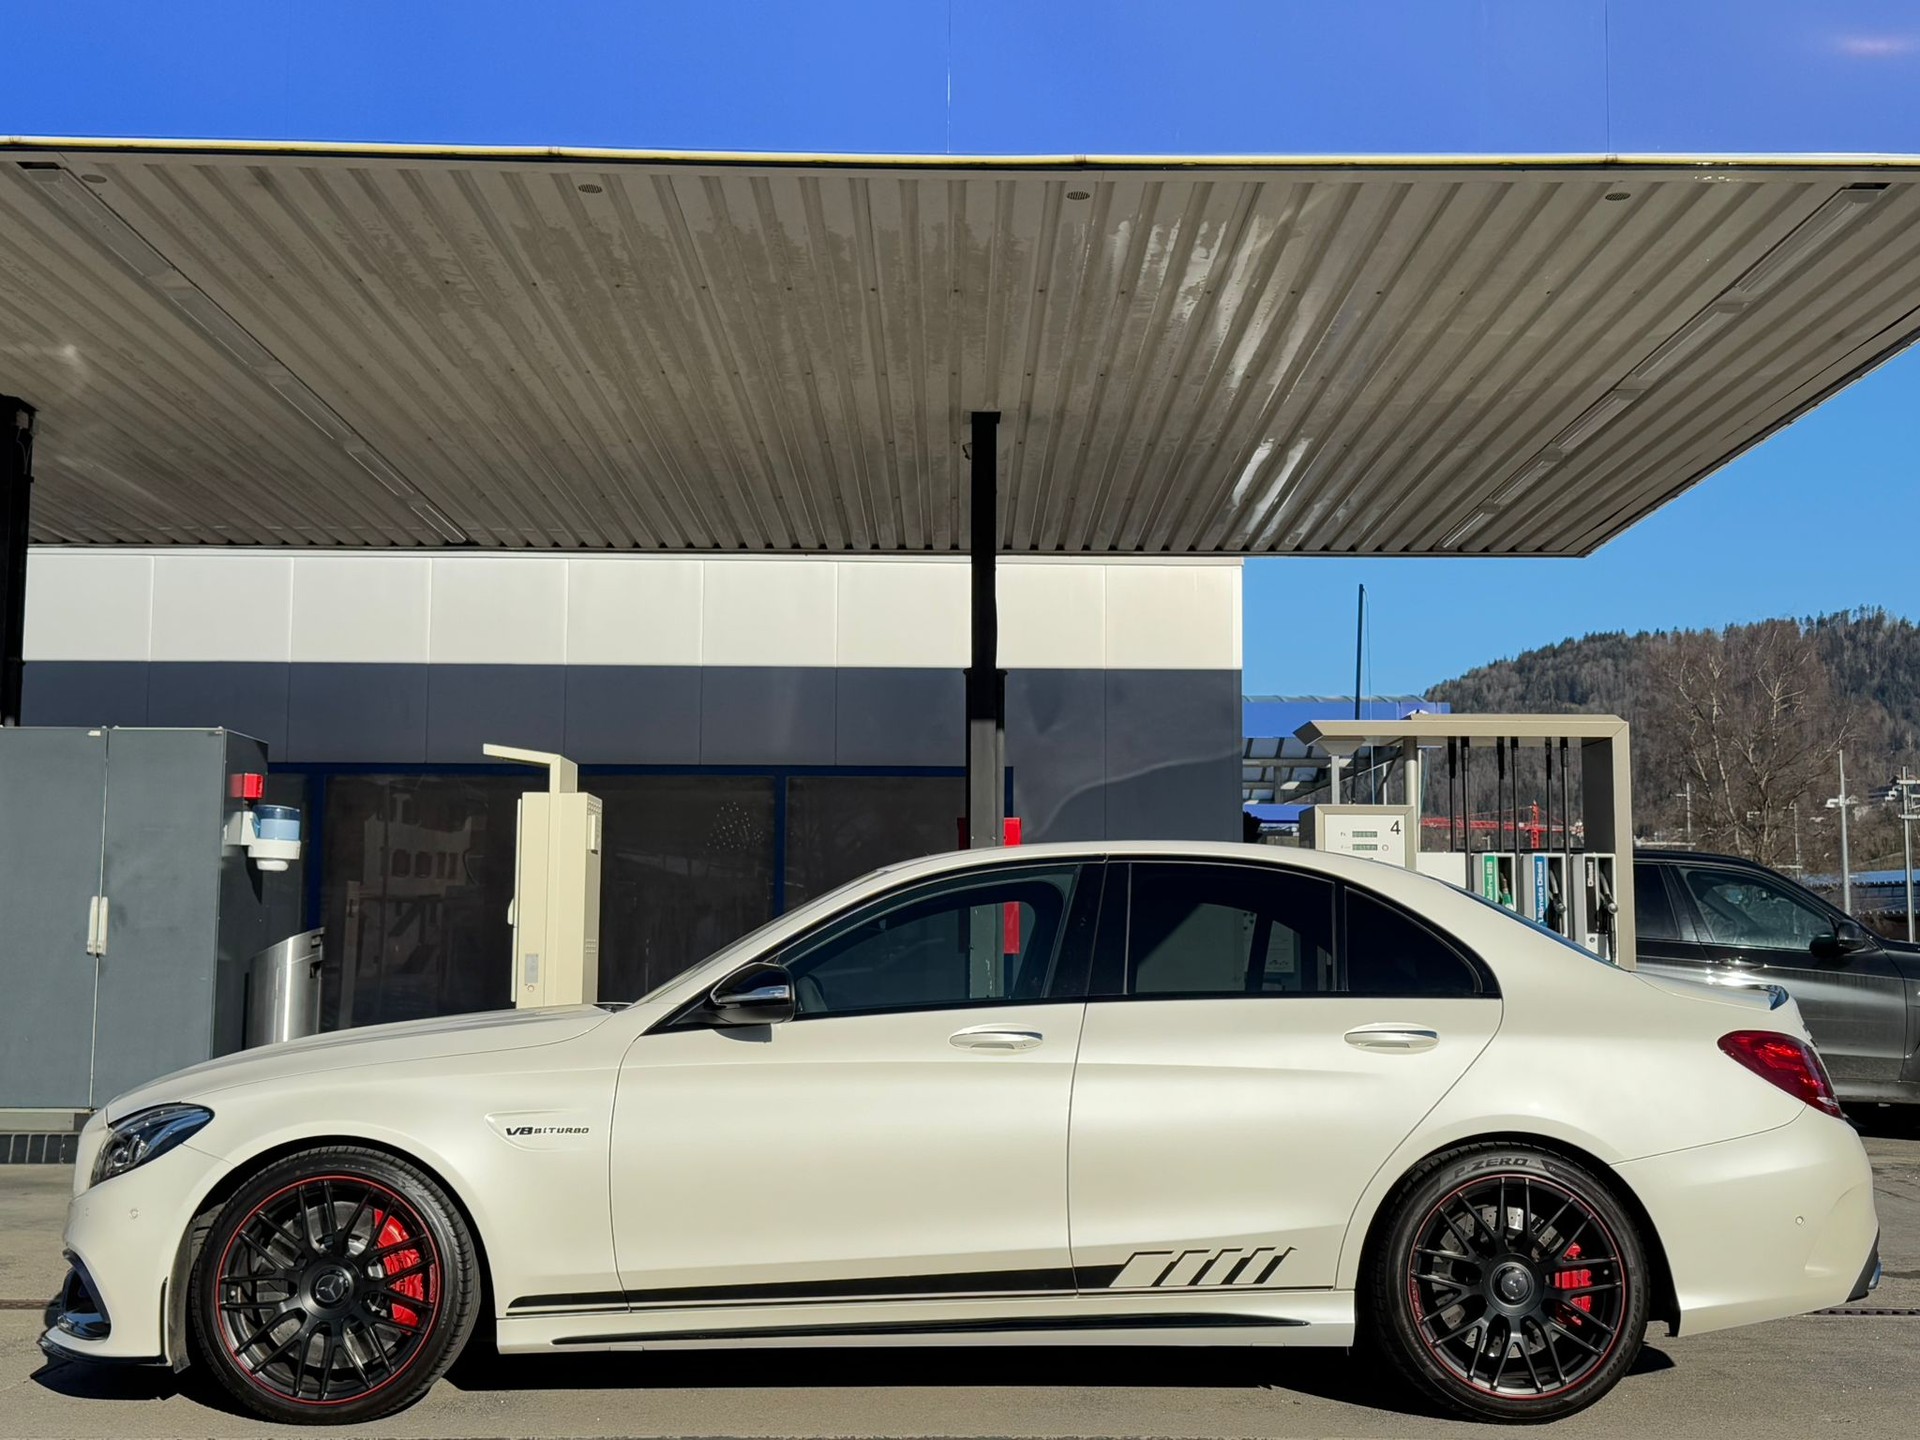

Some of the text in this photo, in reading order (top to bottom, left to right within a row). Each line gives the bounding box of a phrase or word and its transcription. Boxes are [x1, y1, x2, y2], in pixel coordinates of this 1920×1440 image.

[1390, 820, 1401, 835] 4
[506, 1126, 533, 1136] V8
[1470, 1158, 1529, 1170] ZERO
